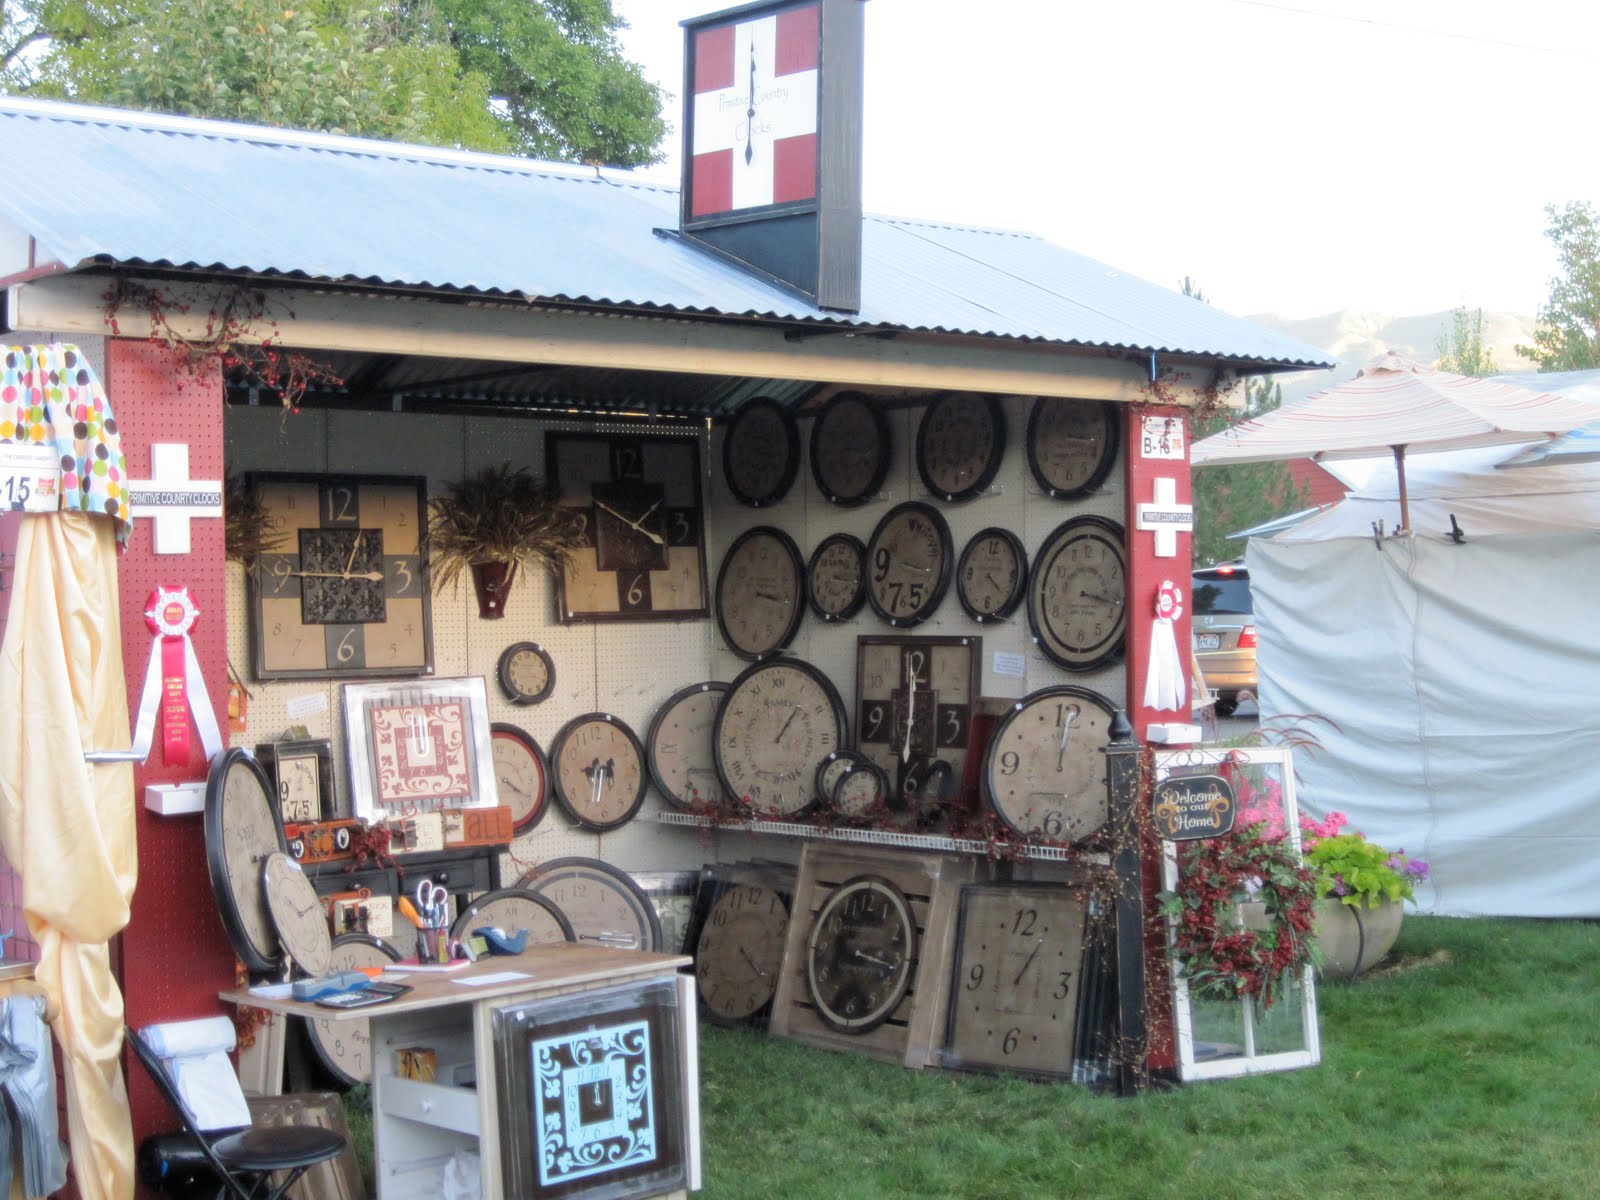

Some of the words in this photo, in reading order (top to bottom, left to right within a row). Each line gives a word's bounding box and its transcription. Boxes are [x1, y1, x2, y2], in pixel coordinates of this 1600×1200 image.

[193, 492, 220, 504] CLOCKS
[327, 488, 356, 521] 12
[674, 512, 688, 544] 3
[274, 557, 292, 593] 9
[393, 561, 412, 594] 3
[874, 548, 891, 583] 9
[628, 574, 643, 605] 6
[888, 582, 904, 614] 7
[909, 584, 924, 610] 5
[336, 628, 355, 662] 6
[904, 650, 927, 684] 12
[772, 678, 786, 688] XII
[867, 706, 883, 738] 9
[946, 710, 960, 744] 3
[1055, 703, 1082, 729] 12
[576, 732, 586, 746] 11
[590, 726, 602, 740] 12
[1000, 751, 1020, 776] 9
[904, 761, 919, 794] 6
[280, 780, 290, 802] 9
[1162, 788, 1222, 806] Welcome
[290, 800, 298, 820] 7
[302, 800, 310, 816] 5
[1043, 810, 1062, 836] 6
[1174, 815, 1214, 830] Home
[730, 891, 743, 910] 11
[844, 899, 858, 917] 11
[862, 894, 874, 912] 12
[882, 903, 888, 920] 1
[1012, 909, 1038, 936] 12
[966, 964, 984, 991] 9
[1052, 972, 1072, 1000] 3
[335, 1040, 345, 1057] 8
[1002, 1027, 1022, 1056] 6
[354, 1053, 362, 1071] 7
